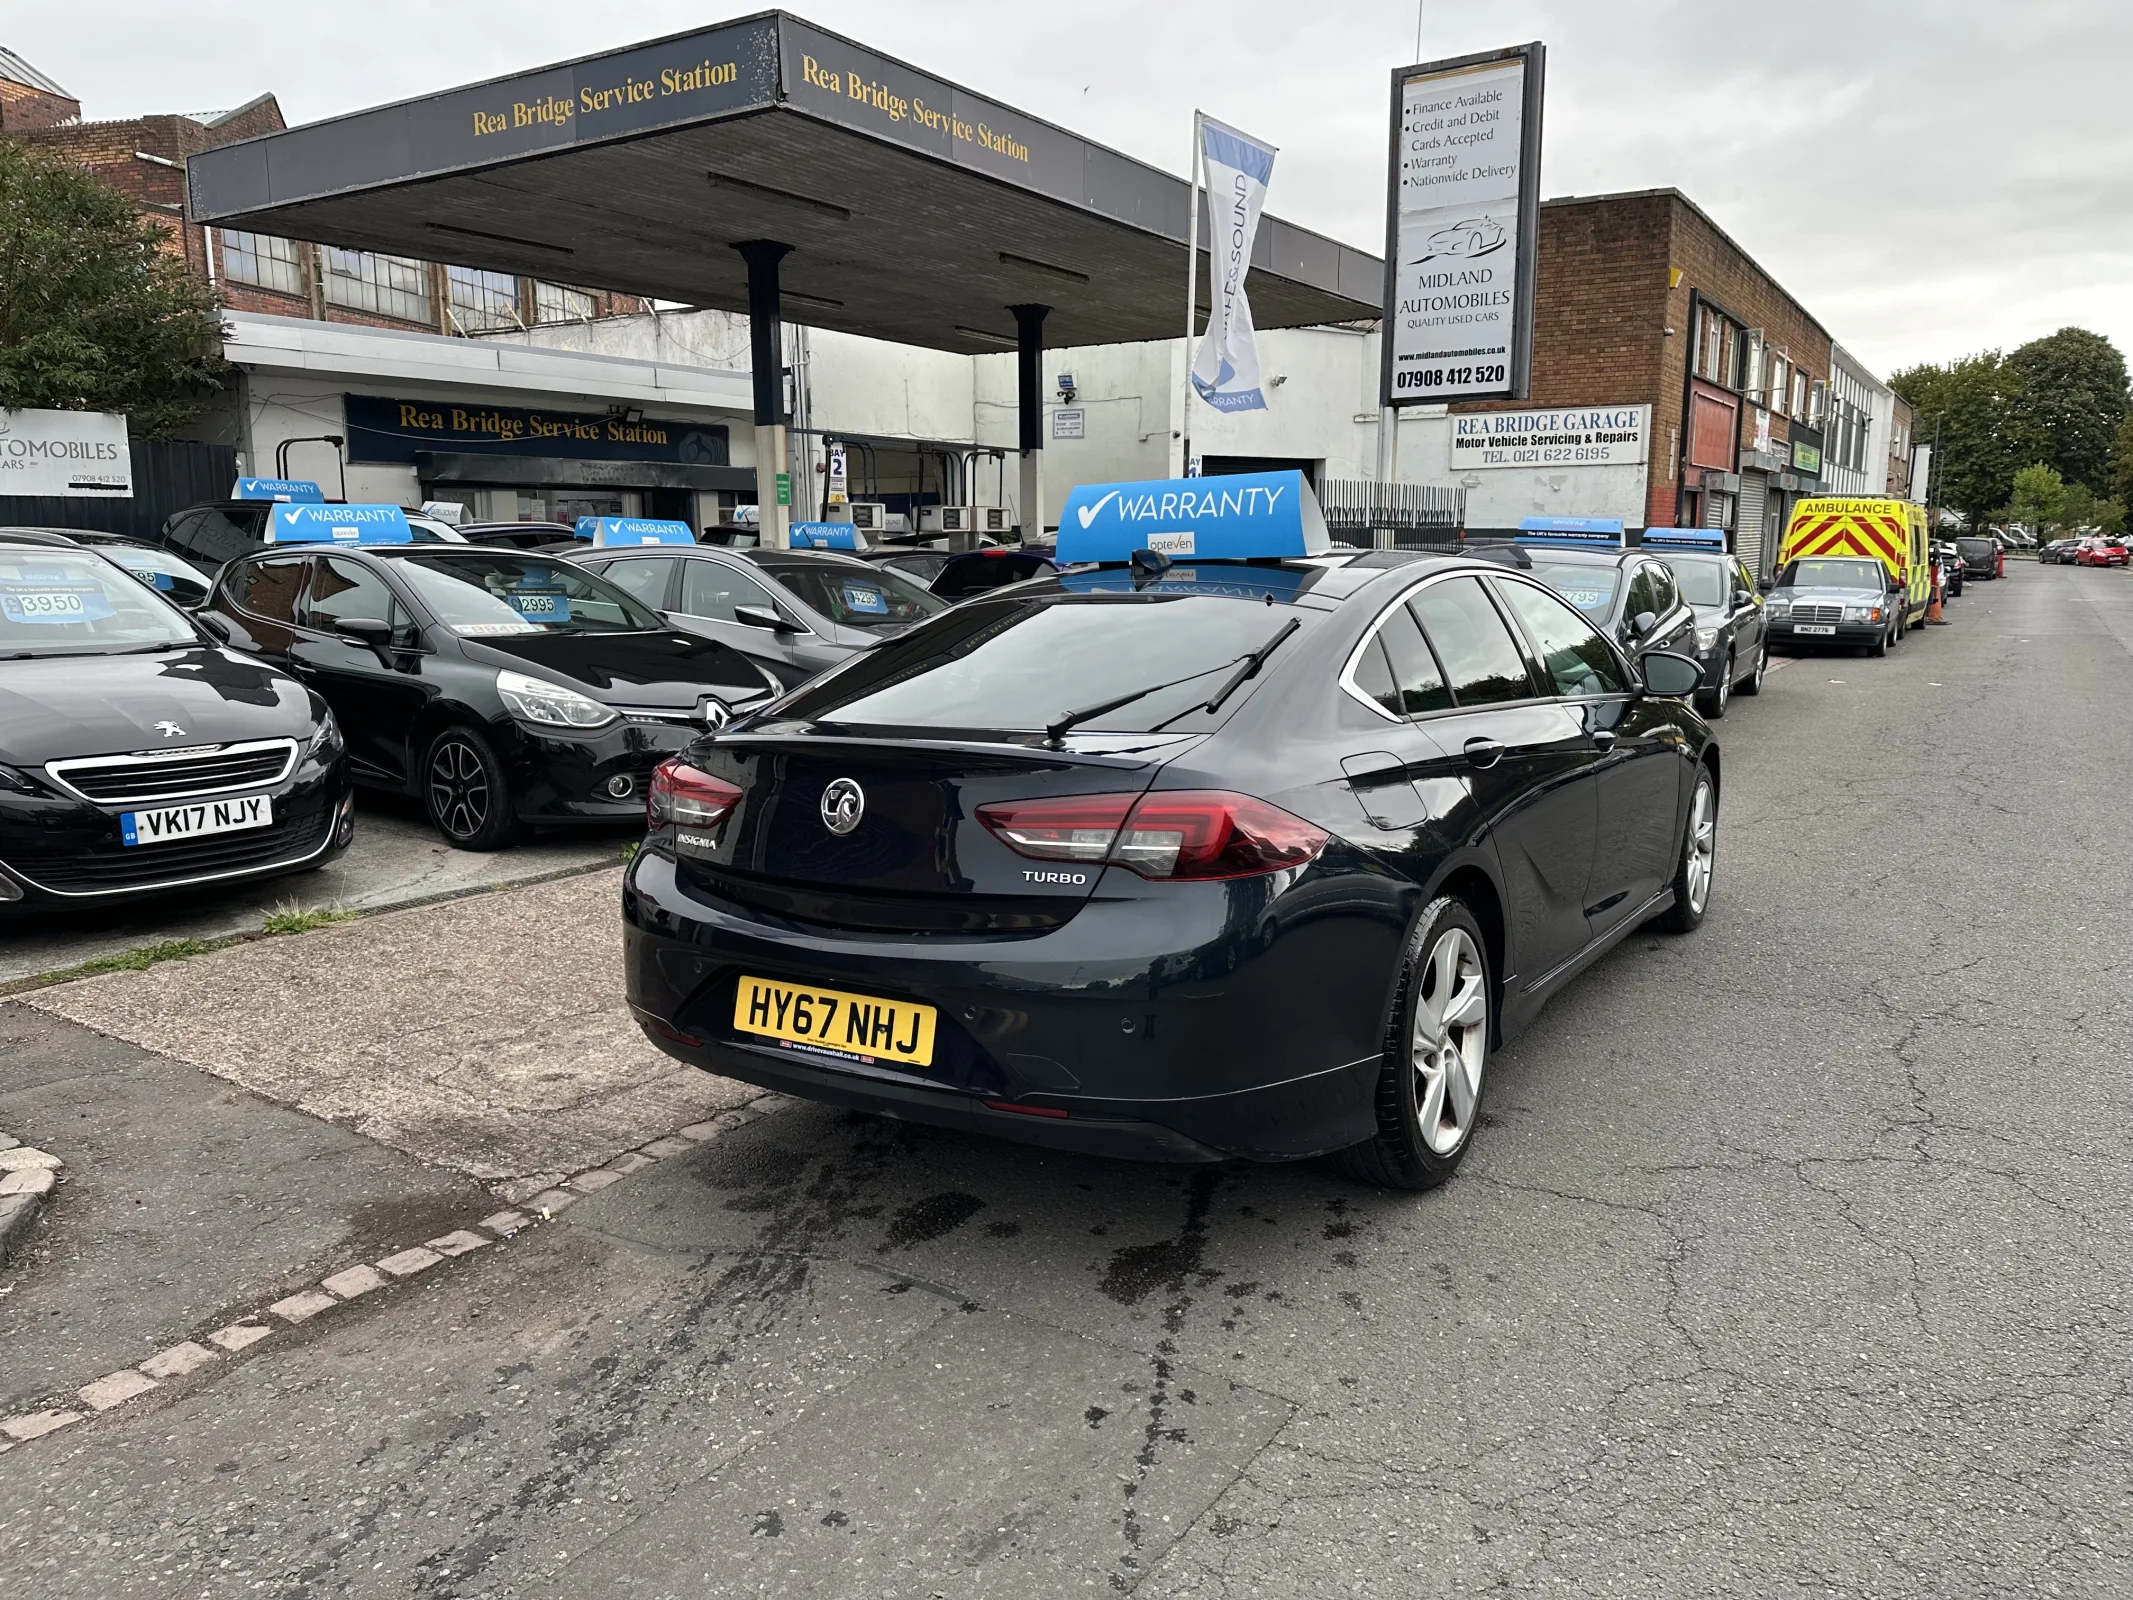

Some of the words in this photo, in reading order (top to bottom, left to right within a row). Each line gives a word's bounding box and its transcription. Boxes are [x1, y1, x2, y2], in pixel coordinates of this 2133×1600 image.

[473, 112, 507, 136] Rea
[512, 97, 574, 126] Bridge
[580, 78, 654, 113] Service
[660, 59, 737, 96] Station
[1413, 101, 1452, 115] Finance
[1454, 90, 1503, 108] Available
[801, 54, 840, 93] Rea
[847, 72, 908, 121] Bridge
[913, 98, 973, 142] Service
[977, 122, 1029, 162] Station
[1412, 119, 1444, 133] Credit
[1447, 114, 1466, 128] and
[1470, 109, 1500, 124] Debit
[1411, 137, 1441, 151] Cards
[1444, 128, 1494, 147] Accepted
[1410, 154, 1457, 169] Warranty
[1410, 169, 1469, 188] Nationwide
[1472, 164, 1517, 179] Delivery
[1419, 268, 1493, 289] MIDLAND
[1400, 290, 1510, 314] AUTOMOBILES
[1408, 317, 1446, 329] QUALITY
[1449, 314, 1472, 324] USED
[1475, 312, 1499, 322] CARS
[1398, 346, 1506, 361] www.midlandautomobiles.co.uk
[1397, 369, 1443, 388] 07908
[1446, 367, 1472, 384] 412
[1475, 365, 1505, 383] 520
[398, 404, 444, 429] Rea
[450, 409, 523, 439] Bridge
[530, 415, 599, 440] Service
[607, 421, 668, 445] Station
[1457, 418, 1490, 435] REA
[1495, 415, 1560, 434] BRIDGE
[1563, 411, 1639, 430] GARAGE
[1456, 437, 1486, 449] Motor
[1488, 434, 1528, 447] Vehicle
[1531, 433, 1581, 447] Servicing
[1585, 433, 1592, 443] &
[1596, 430, 1638, 443] Repairs
[1483, 450, 1509, 463] TEL.
[1513, 450, 1539, 462] 0121
[1544, 448, 1570, 461] 622
[1575, 446, 1610, 460] 6195
[0, 460, 24, 469] ARS
[833, 458, 842, 475] 2
[98, 475, 110, 483] 412
[259, 482, 314, 494] WARRANTY
[1118, 486, 1285, 521] WARRANTY
[1804, 503, 1893, 514] AMBULANCE
[307, 509, 396, 523] WARRANTY
[624, 522, 684, 535] WARRANTY
[805, 527, 851, 537] WARRANTY
[1150, 535, 1193, 552] opteven
[146, 806, 206, 836] VK17
[214, 799, 260, 826] NJY
[125, 832, 136, 840] GB
[677, 834, 716, 850] INSIGNIA
[1022, 871, 1086, 885] TURBO
[749, 985, 838, 1038] HY67
[846, 1002, 920, 1055] NHJ
